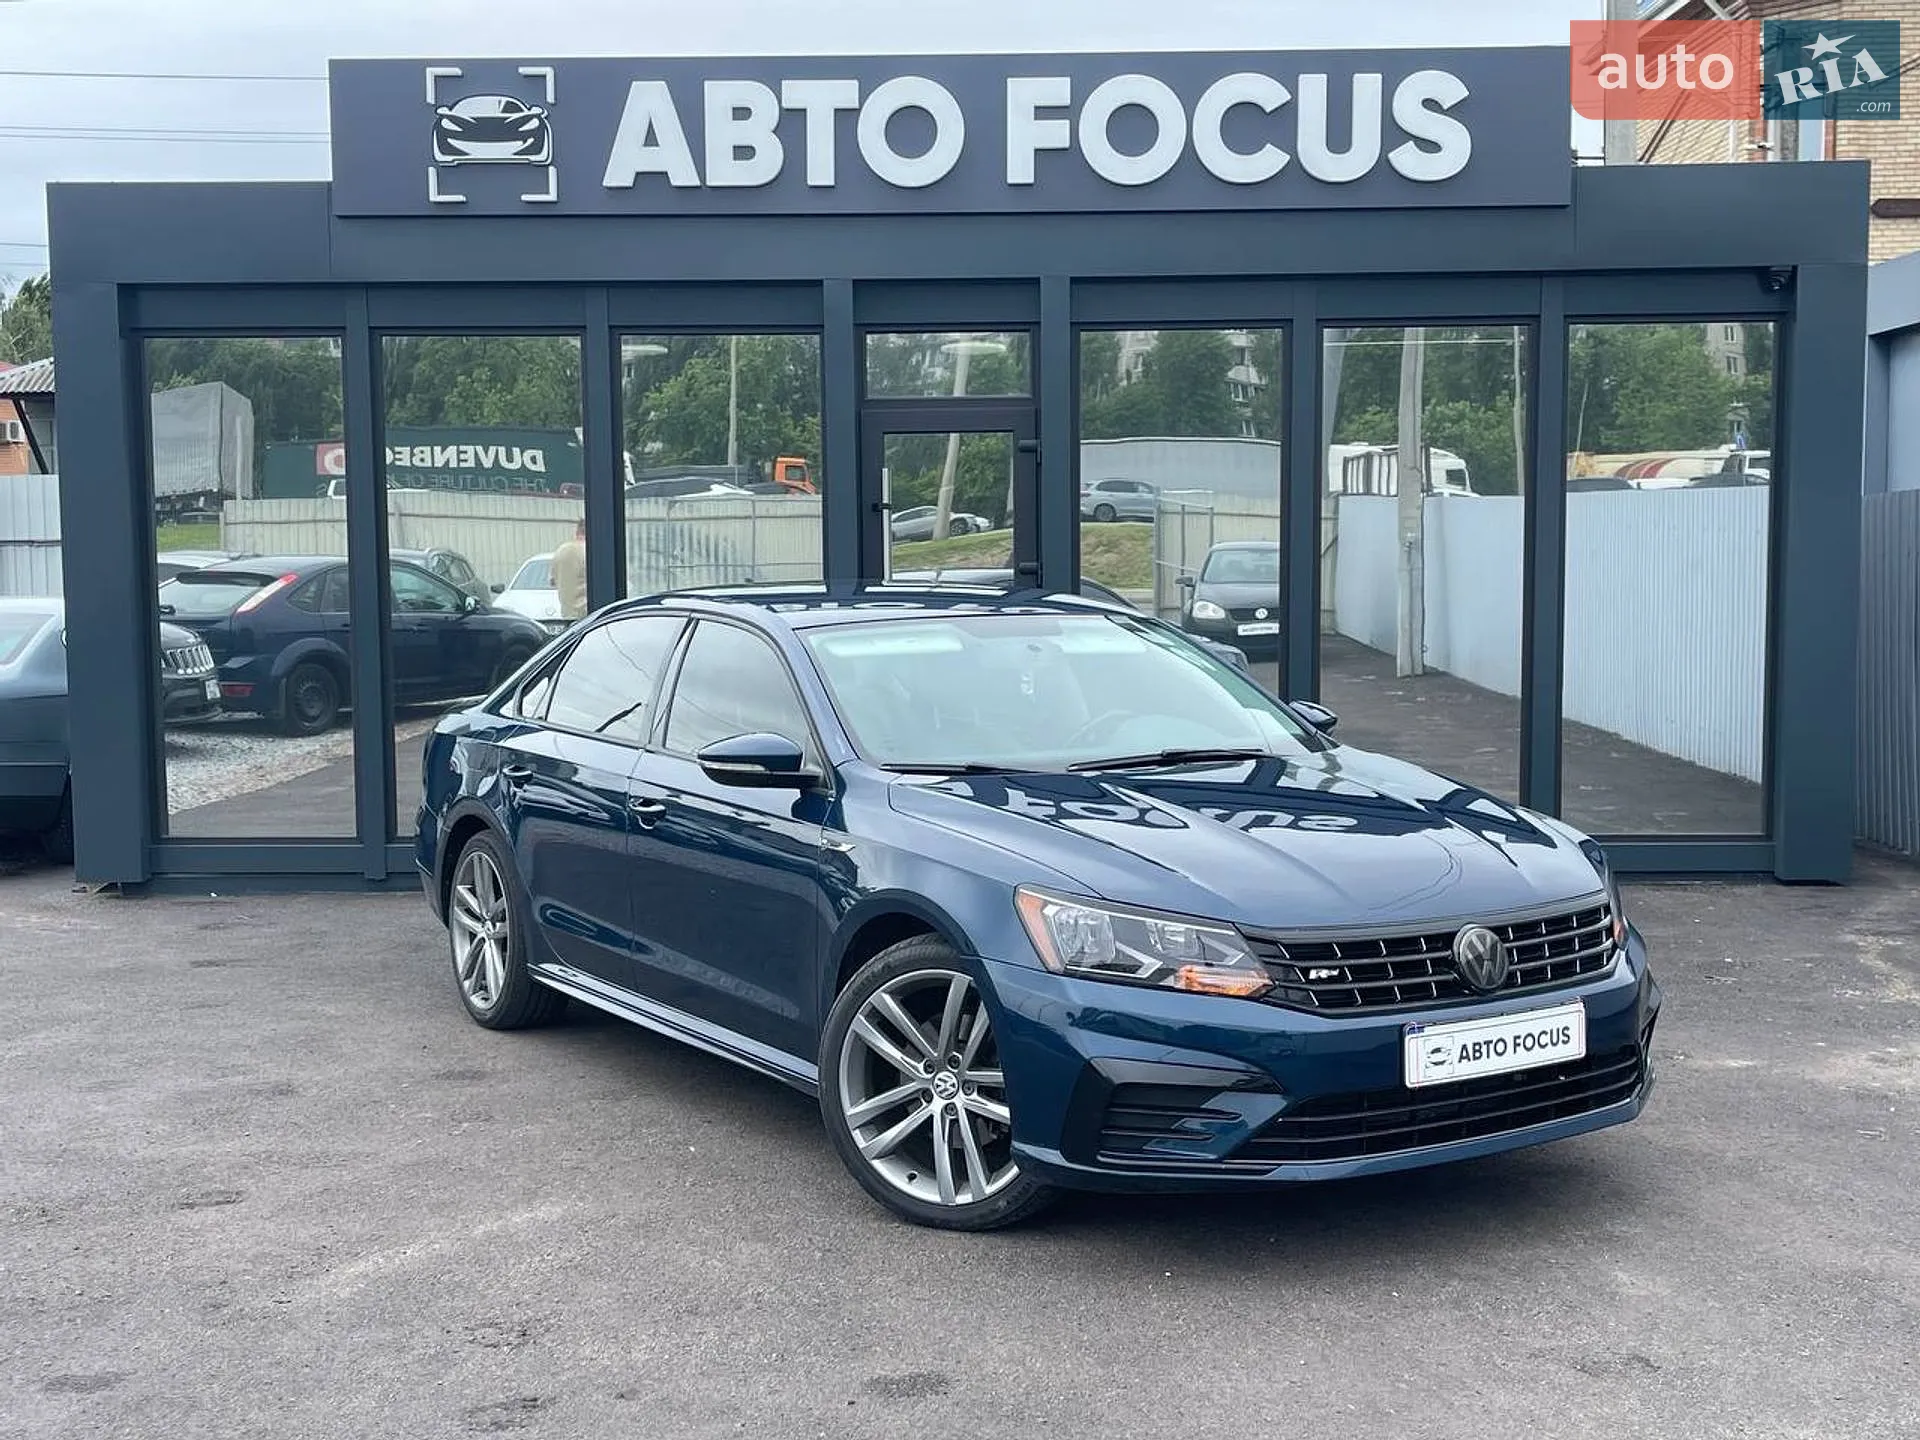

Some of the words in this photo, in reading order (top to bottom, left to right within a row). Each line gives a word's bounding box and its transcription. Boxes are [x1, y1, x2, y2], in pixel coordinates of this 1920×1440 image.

[602, 76, 965, 188] АВТО
[1006, 70, 1472, 186] FOCUS
[1458, 1038, 1508, 1063] АВТО
[1513, 1025, 1571, 1054] FOCUS
